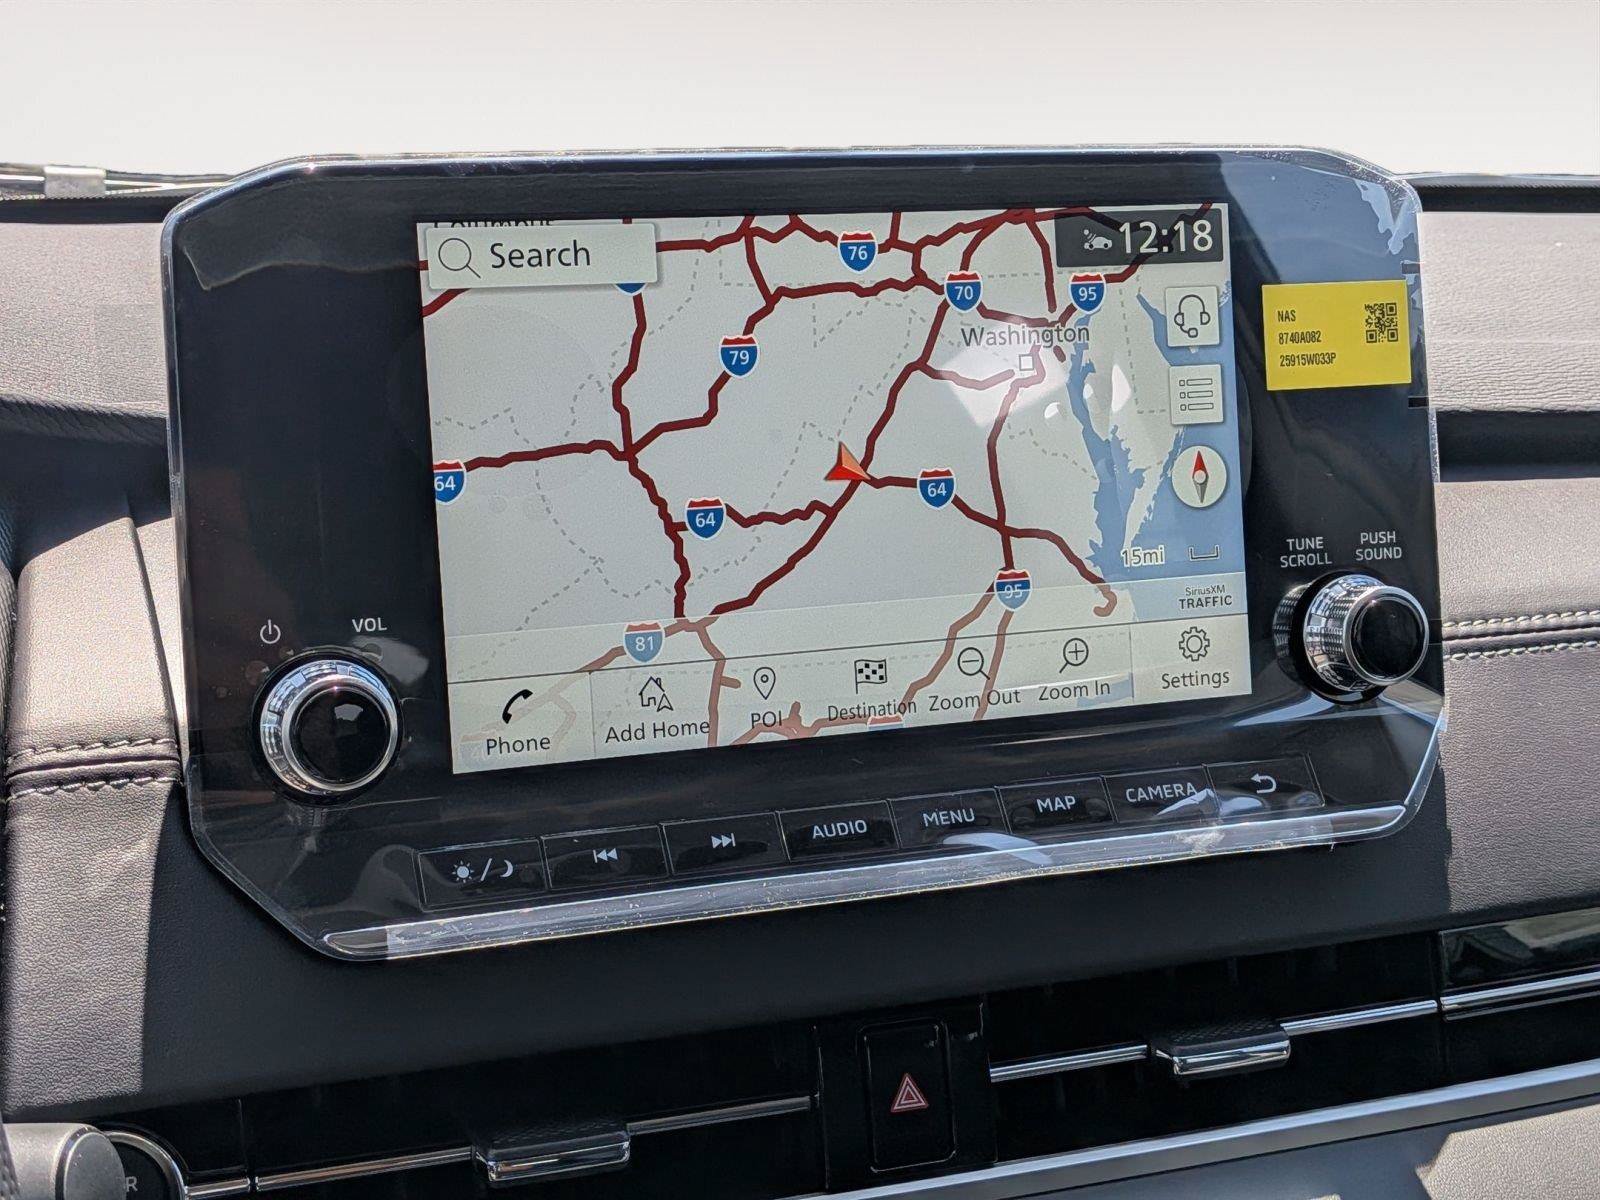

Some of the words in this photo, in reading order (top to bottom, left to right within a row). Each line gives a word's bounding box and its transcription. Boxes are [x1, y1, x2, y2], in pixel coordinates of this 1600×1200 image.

[1118, 218, 1214, 255] 12:18
[490, 240, 591, 269] Search
[847, 245, 869, 261] 76
[954, 285, 975, 300] 70
[1078, 286, 1097, 301] 95
[1277, 309, 1297, 323] NAS
[961, 323, 1090, 348] Washington
[1278, 330, 1322, 345] 8740A082
[729, 350, 749, 365] 79
[435, 476, 456, 491] 64
[927, 480, 948, 496] 64
[695, 512, 717, 528] 64
[1286, 536, 1324, 551] TUNE
[1360, 530, 1396, 545] PUSH
[1121, 547, 1165, 566] 15mi
[1280, 552, 1333, 568] SCROLL
[1355, 546, 1402, 561] SOUND
[1004, 583, 1024, 598] 95
[1185, 584, 1226, 596] SiriusXM
[1179, 595, 1233, 610] TRAFFIC
[351, 616, 388, 633] VOL
[635, 635, 655, 652] 81
[1161, 669, 1231, 691] Settings
[1038, 683, 1090, 701] Zoom
[1094, 680, 1112, 696] In
[928, 693, 982, 711] Zoom
[986, 688, 1021, 706] Out
[827, 698, 918, 723] Destination
[751, 711, 783, 729] POI
[605, 724, 646, 744] Add
[653, 719, 712, 740] Home
[486, 736, 551, 756] Phone
[1125, 782, 1197, 803] CAMERA
[1036, 796, 1076, 814] MAP
[922, 808, 975, 828] MENU
[812, 819, 868, 840] AUDIO
